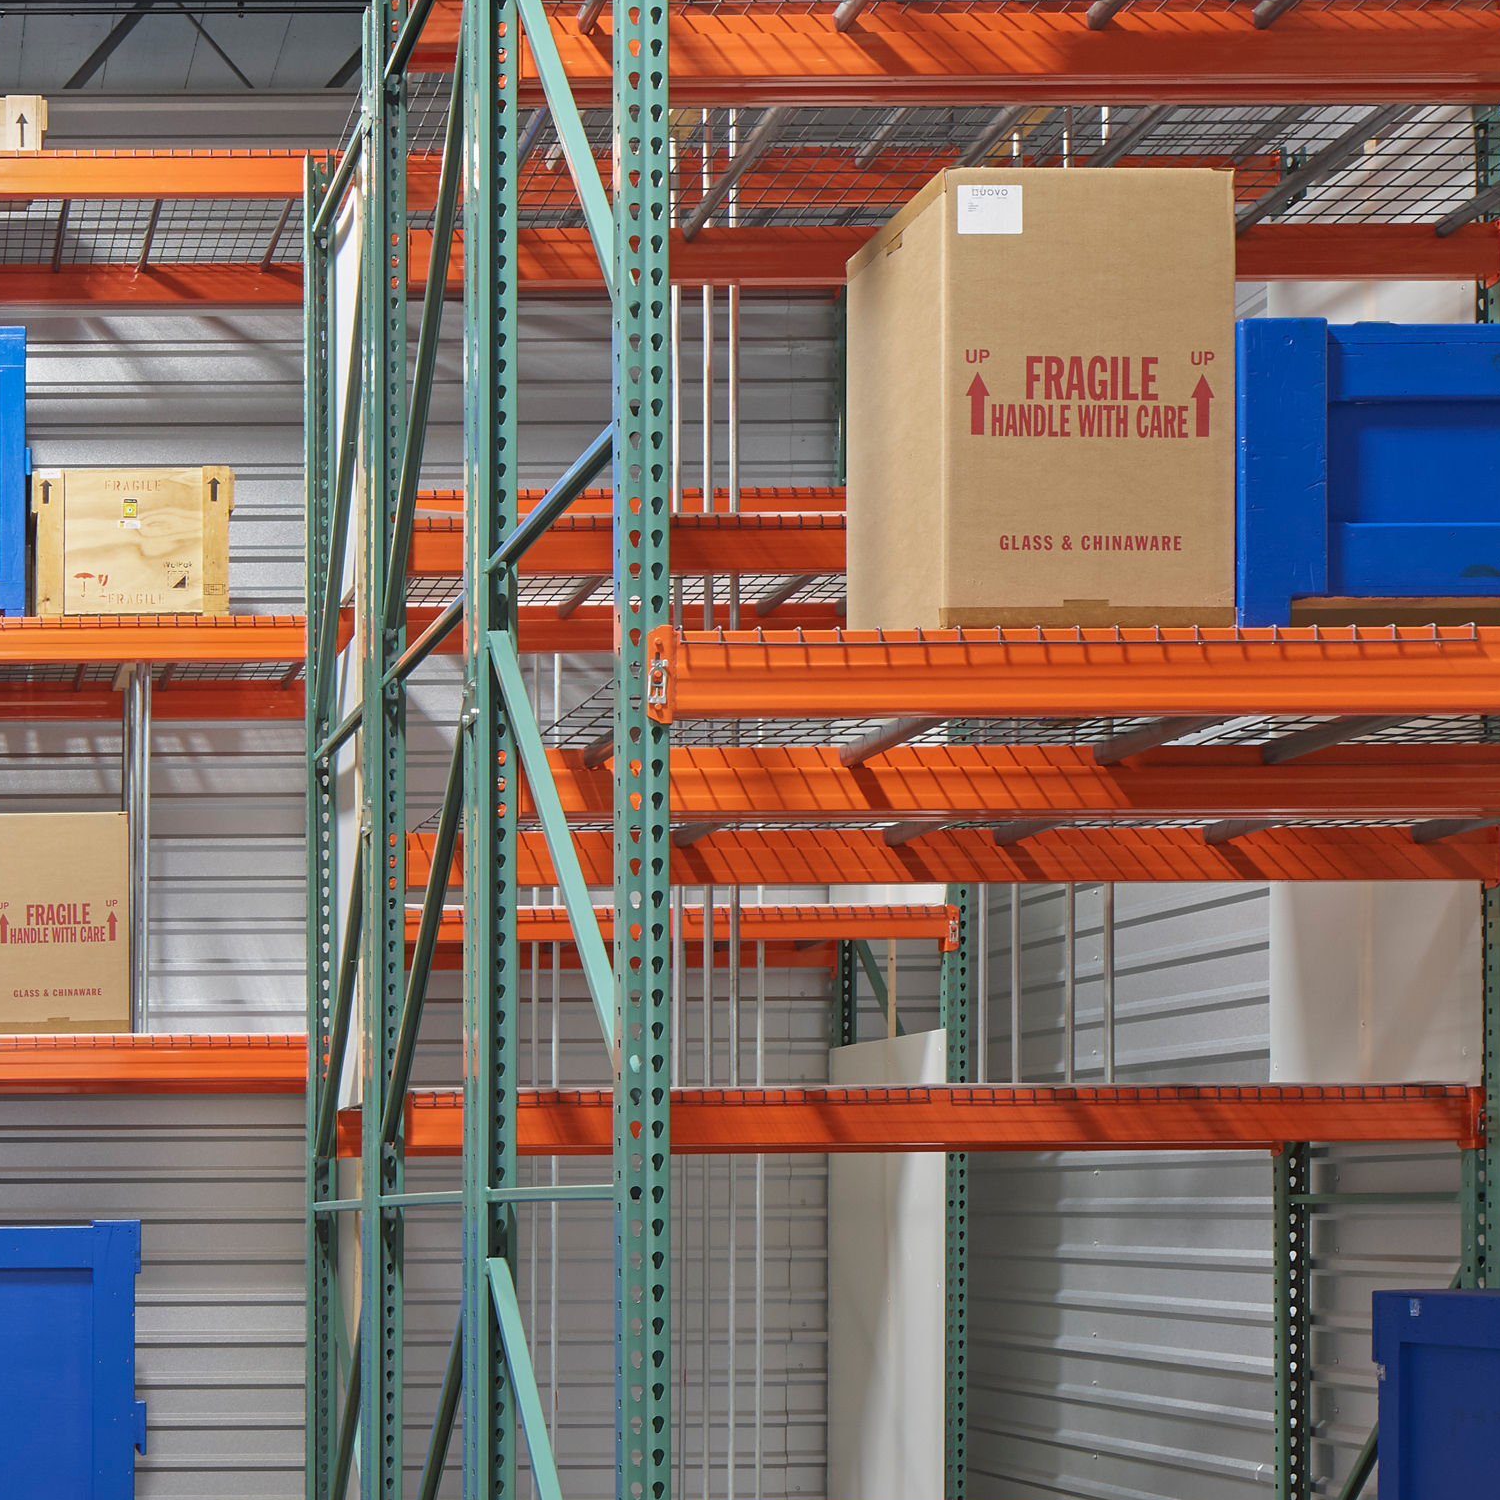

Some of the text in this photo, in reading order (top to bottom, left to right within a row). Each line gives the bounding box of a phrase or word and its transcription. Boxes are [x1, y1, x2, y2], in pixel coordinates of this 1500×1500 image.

[980, 188, 1008, 196] UOVO
[965, 349, 990, 364] UP
[1190, 351, 1215, 366] UP
[1025, 355, 1159, 401] FRAGILE
[991, 404, 1189, 438] HANDLE WITH CARE
[104, 479, 162, 492] FRAGILE
[999, 534, 1182, 551] GLASS & CHINAWARE
[107, 593, 165, 605] FRAGILE
[105, 899, 118, 907] UP
[26, 903, 91, 926] FRAGILE
[10, 925, 106, 944] HANDLE WITH CARE
[13, 987, 102, 998] GLASS & CHINAWARE
